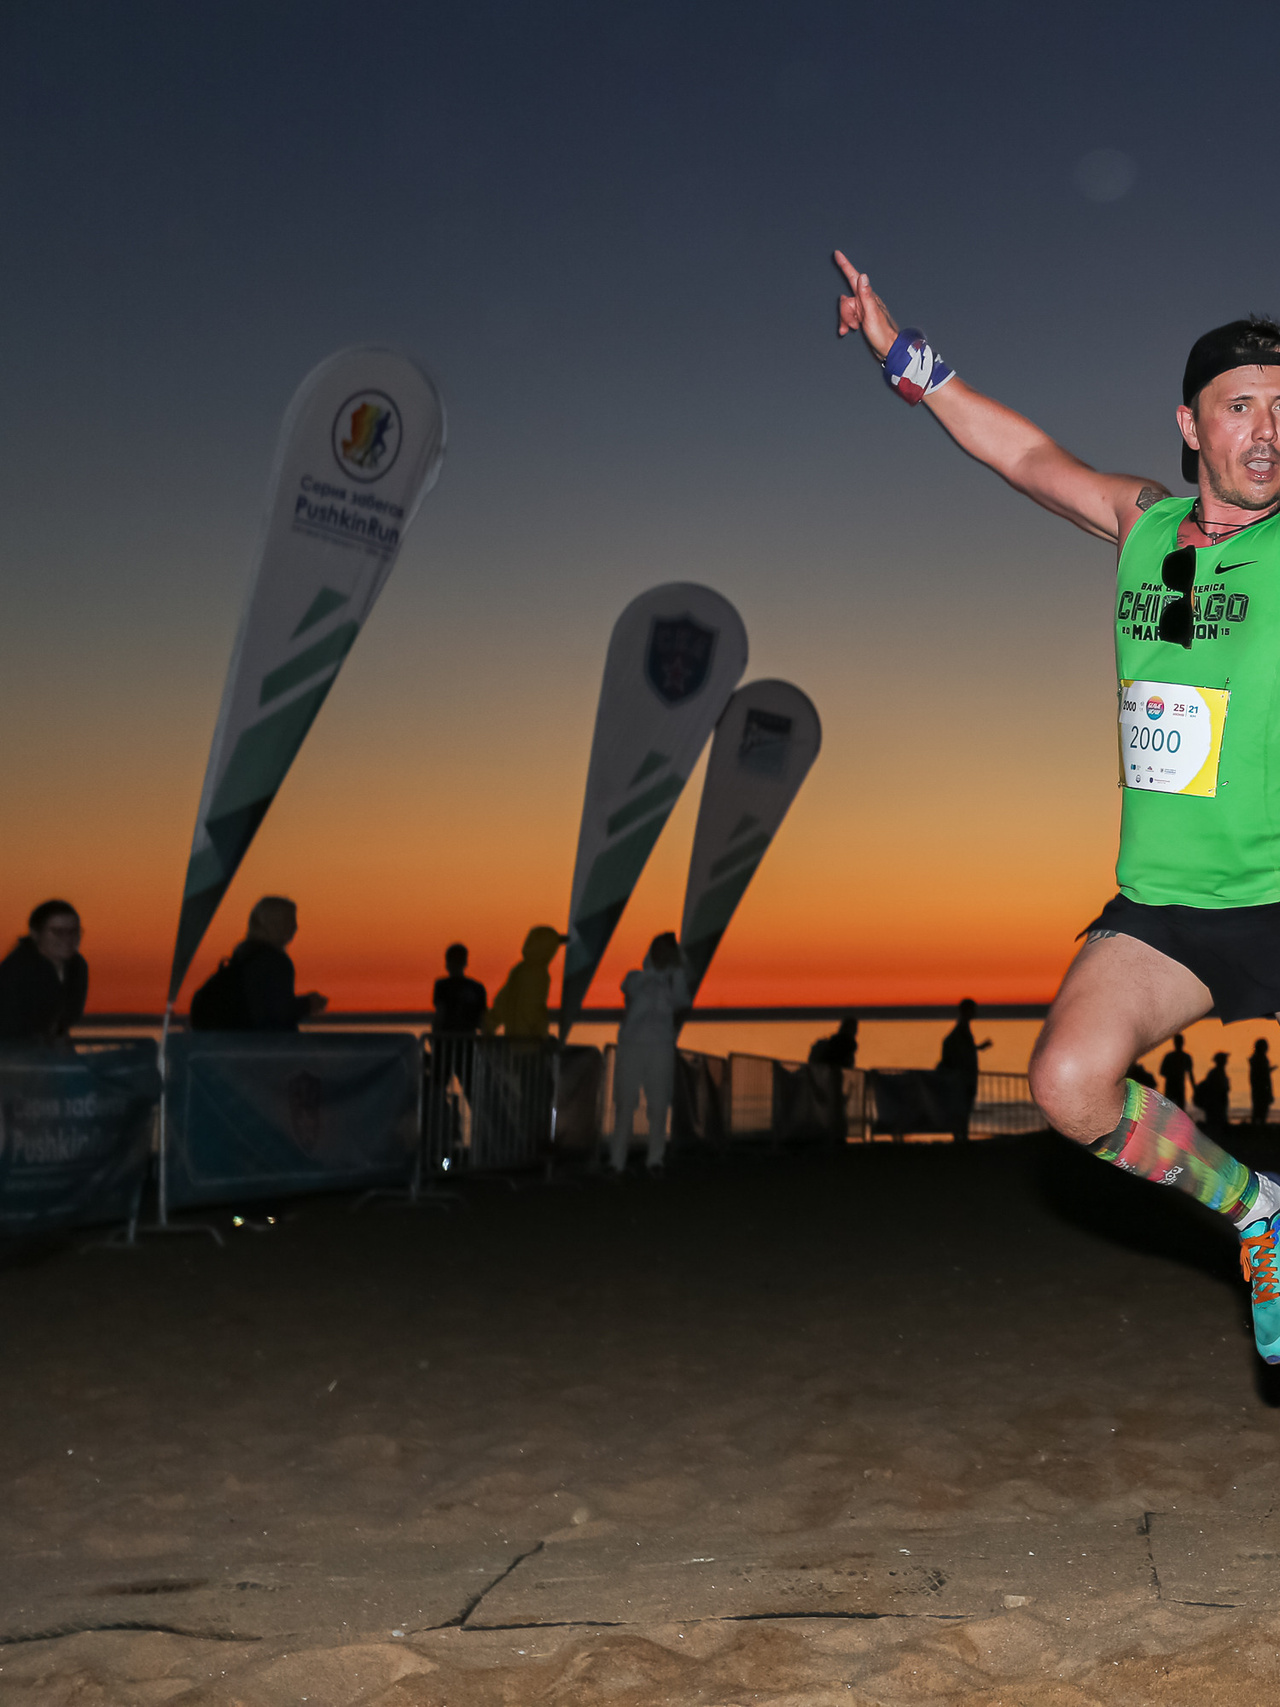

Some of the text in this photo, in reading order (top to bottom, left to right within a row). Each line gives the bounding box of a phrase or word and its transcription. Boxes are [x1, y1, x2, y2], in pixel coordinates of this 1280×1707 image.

[295, 494, 399, 545] PushkinRun
[1221, 627, 1230, 636] 15
[1173, 703, 1185, 712] 25
[1188, 705, 1198, 714] 21
[1130, 726, 1181, 753] 2000
